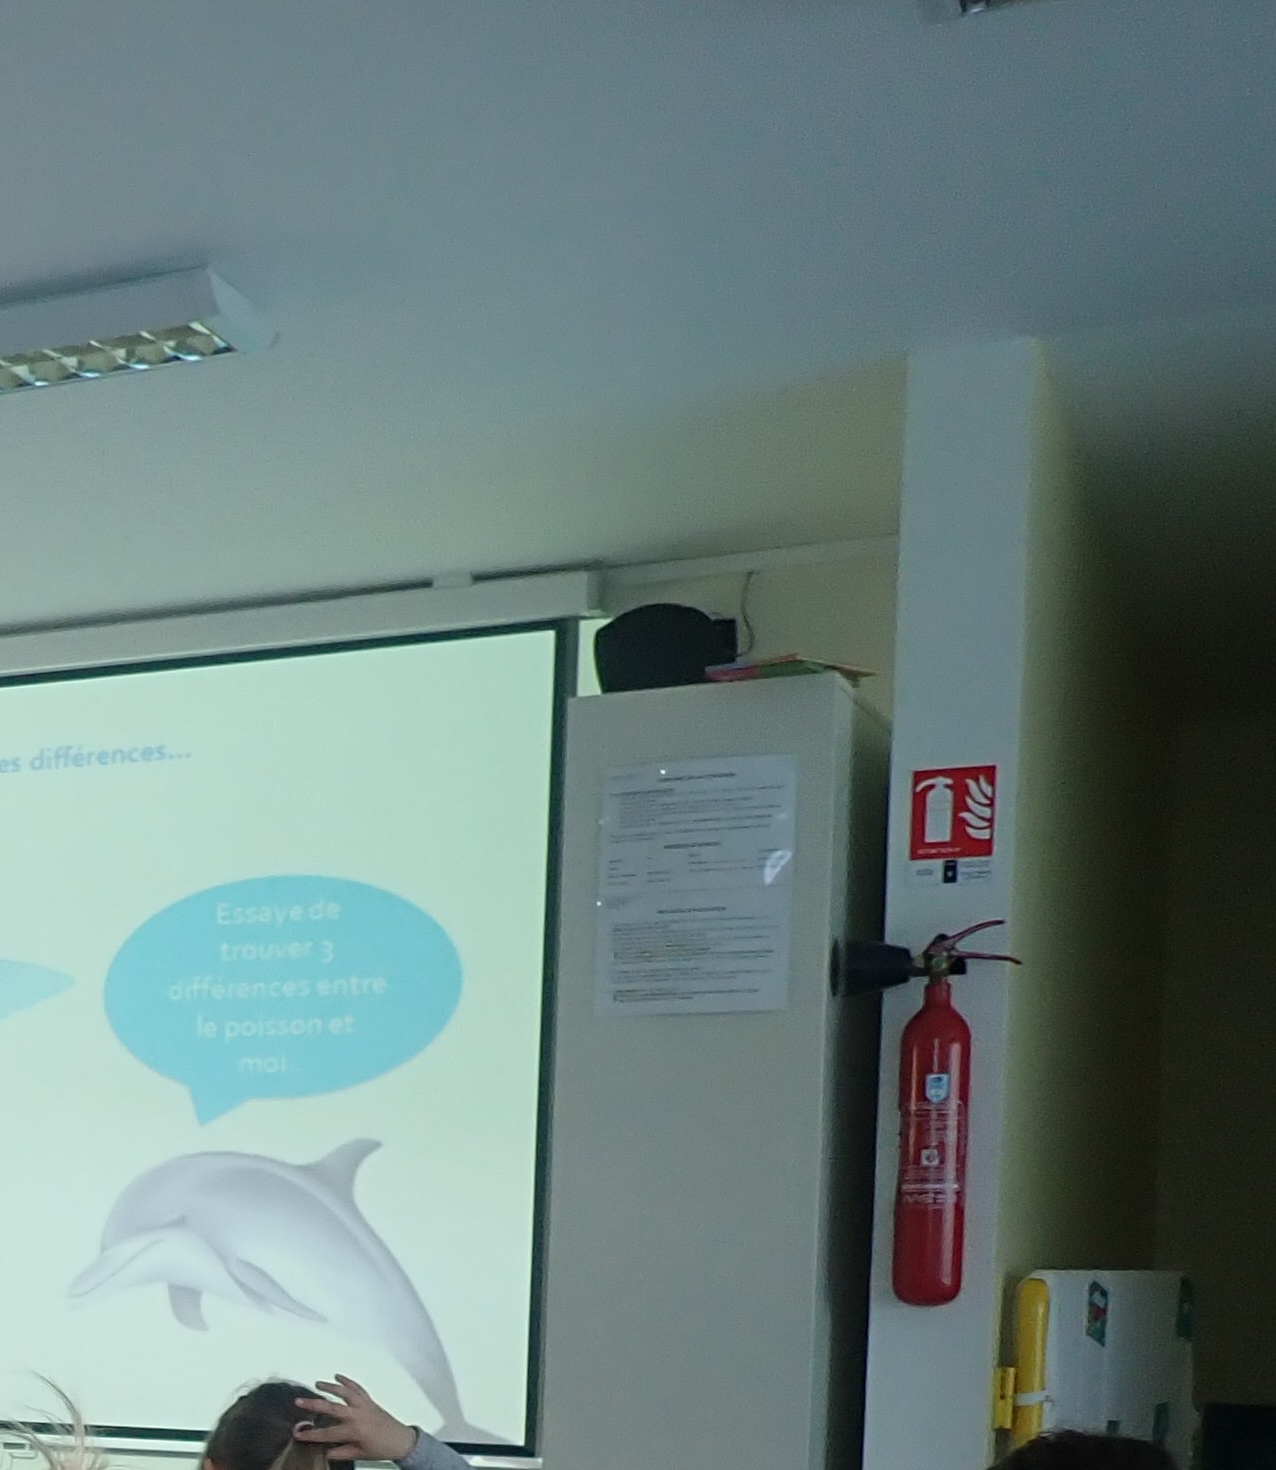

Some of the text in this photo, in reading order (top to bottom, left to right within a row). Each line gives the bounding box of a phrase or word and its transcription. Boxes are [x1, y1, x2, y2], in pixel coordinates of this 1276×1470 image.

[216, 898, 341, 928] Essaye de
[220, 940, 335, 963] trouver 3
[168, 975, 388, 1000] différences entre
[196, 1013, 356, 1043] le poisson et
